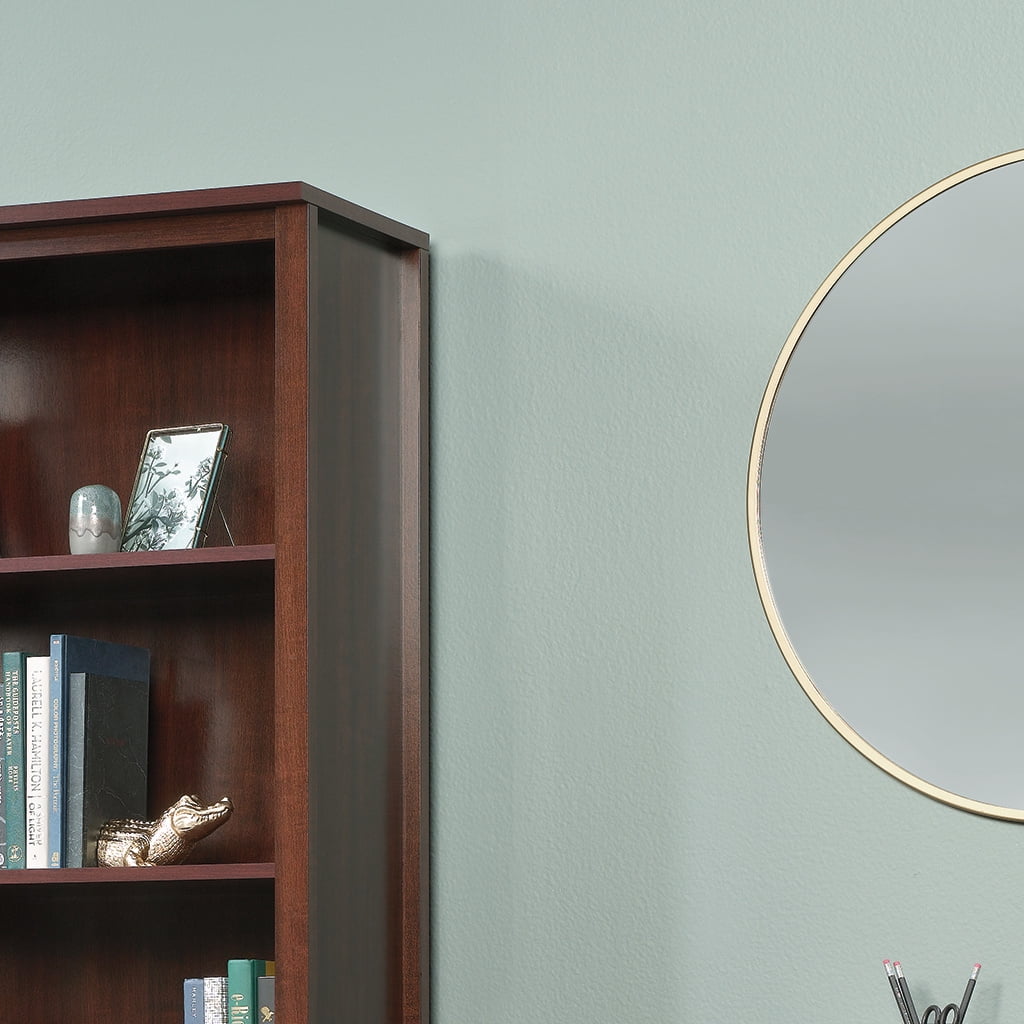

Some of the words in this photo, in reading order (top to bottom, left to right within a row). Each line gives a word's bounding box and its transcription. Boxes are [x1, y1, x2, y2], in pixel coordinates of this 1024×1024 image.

[31, 670, 42, 719] LAURELL
[0, 697, 4, 707] in
[6, 716, 12, 725] OF
[31, 721, 42, 732] K.
[31, 734, 42, 792] HAMILTON
[28, 803, 35, 815] OF
